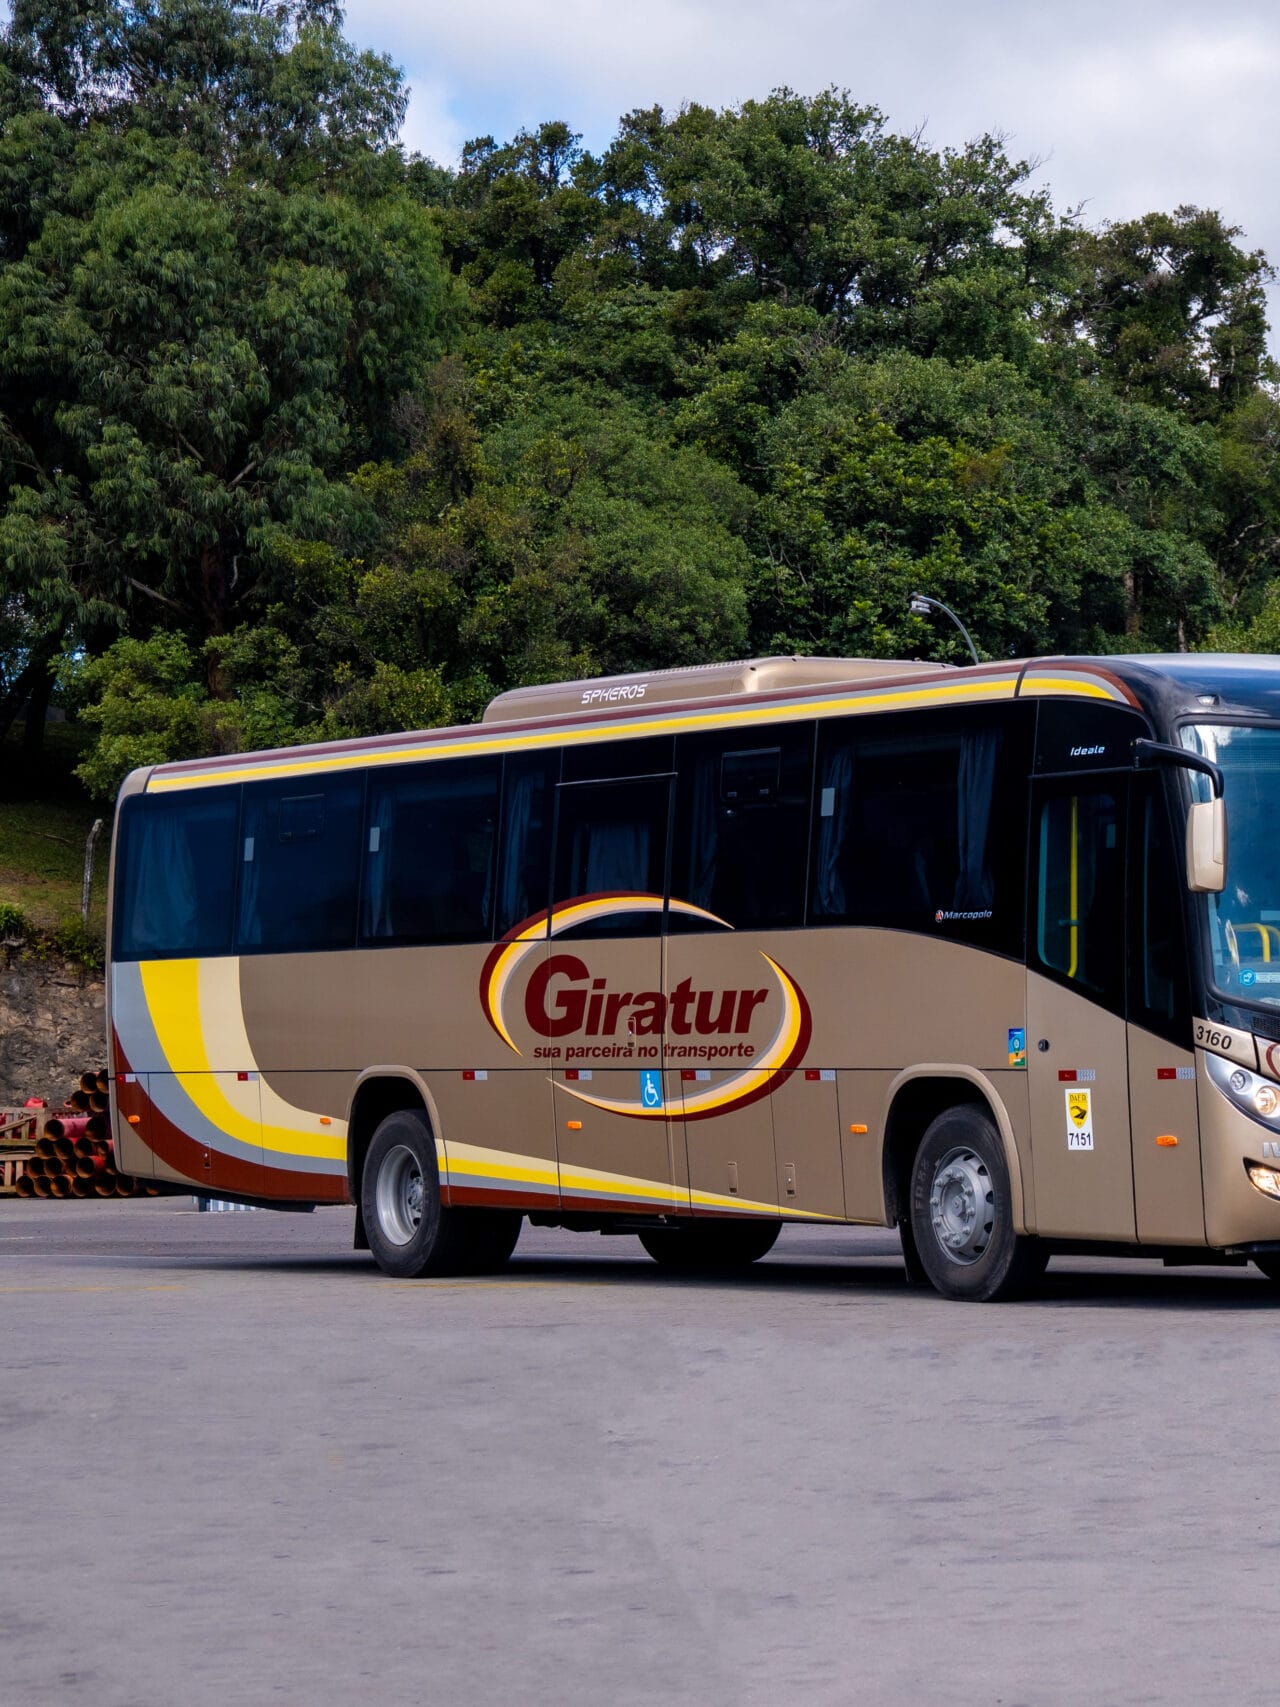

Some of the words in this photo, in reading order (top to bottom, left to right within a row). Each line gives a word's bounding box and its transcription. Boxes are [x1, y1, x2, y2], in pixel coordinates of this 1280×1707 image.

[581, 683, 649, 704] SPHEROS
[1070, 745, 1105, 756] Ideale
[943, 909, 993, 920] Marcopolo
[524, 954, 769, 1038] Giratur
[1196, 1025, 1232, 1050] 3160
[533, 1045, 561, 1059] sua
[564, 1043, 634, 1061] parceira
[637, 1043, 658, 1058] no
[663, 1042, 755, 1061] transporte
[1068, 1132, 1091, 1146] 7151
